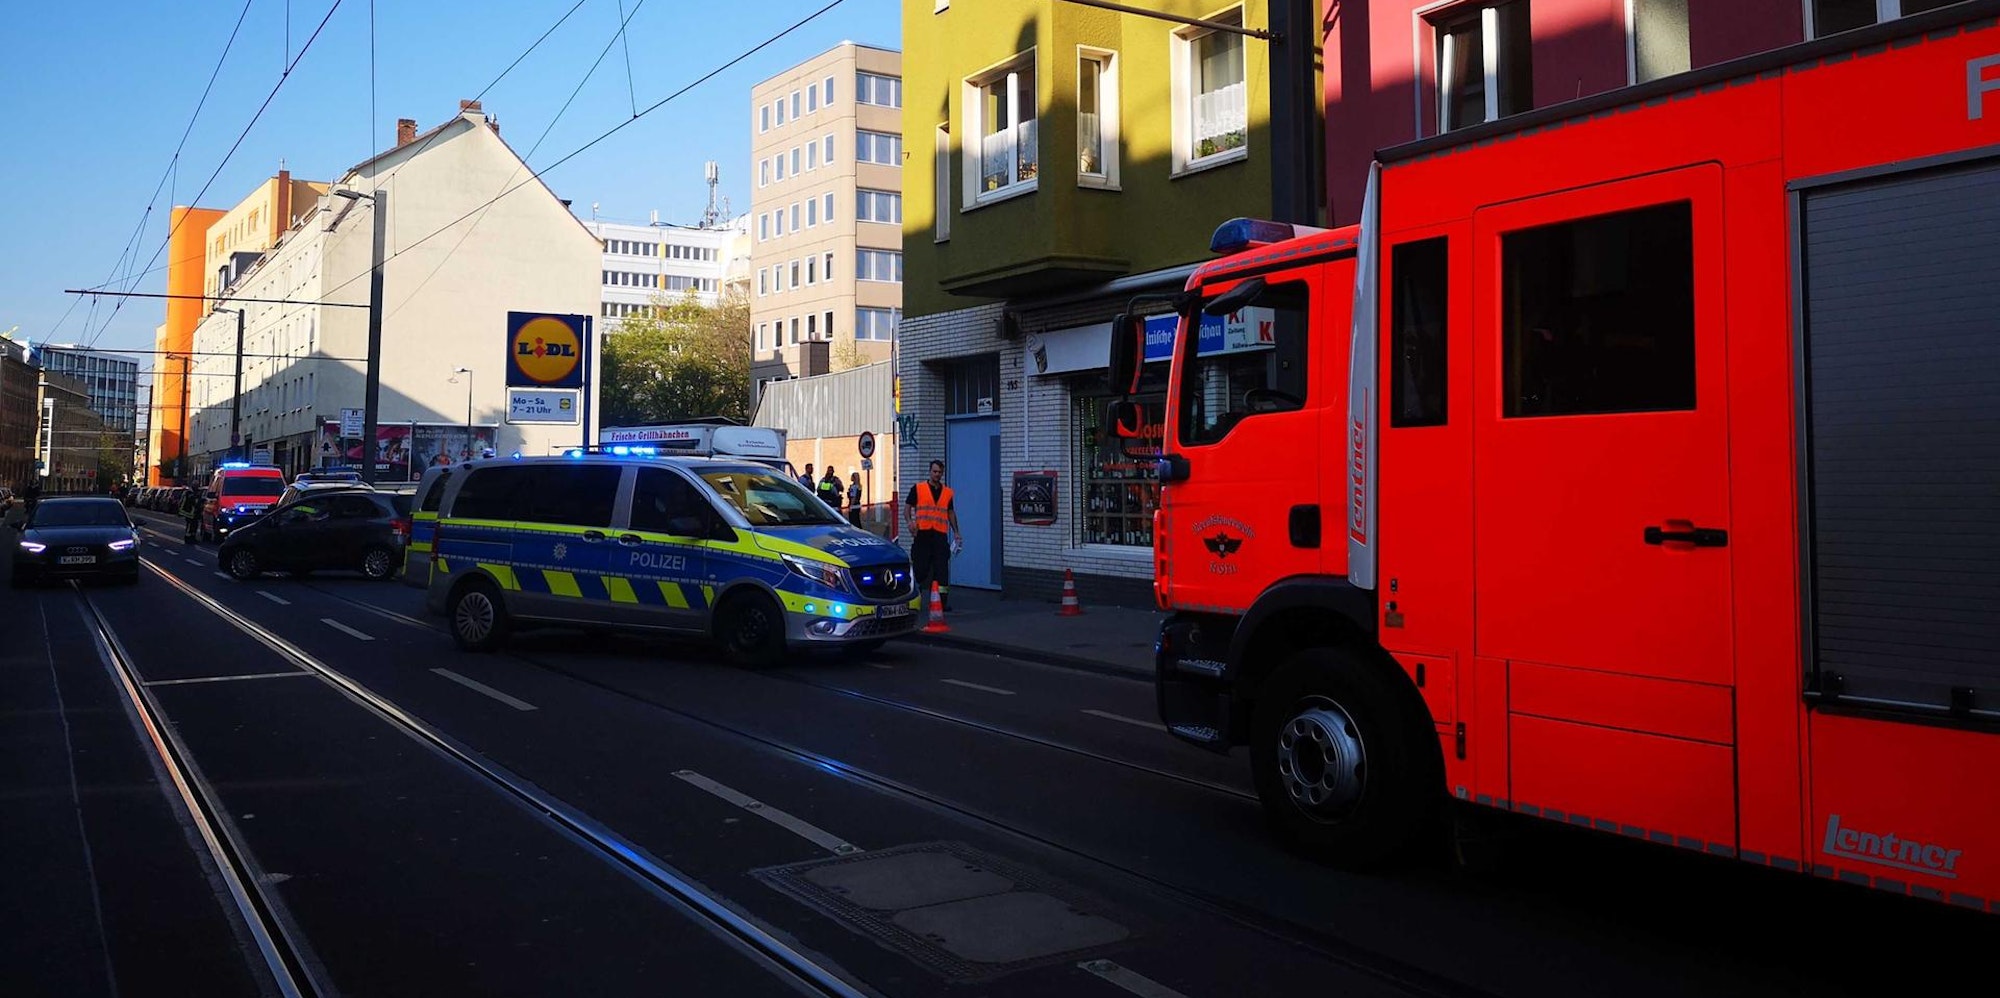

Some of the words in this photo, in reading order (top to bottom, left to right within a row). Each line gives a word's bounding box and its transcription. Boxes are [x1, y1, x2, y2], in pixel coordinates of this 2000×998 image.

[611, 432, 636, 441] Frische
[638, 430, 689, 440] Grillhähnchen
[1350, 417, 1367, 547] Lentner
[630, 551, 686, 571] POLIZEI
[1823, 813, 1962, 879] Lentner
